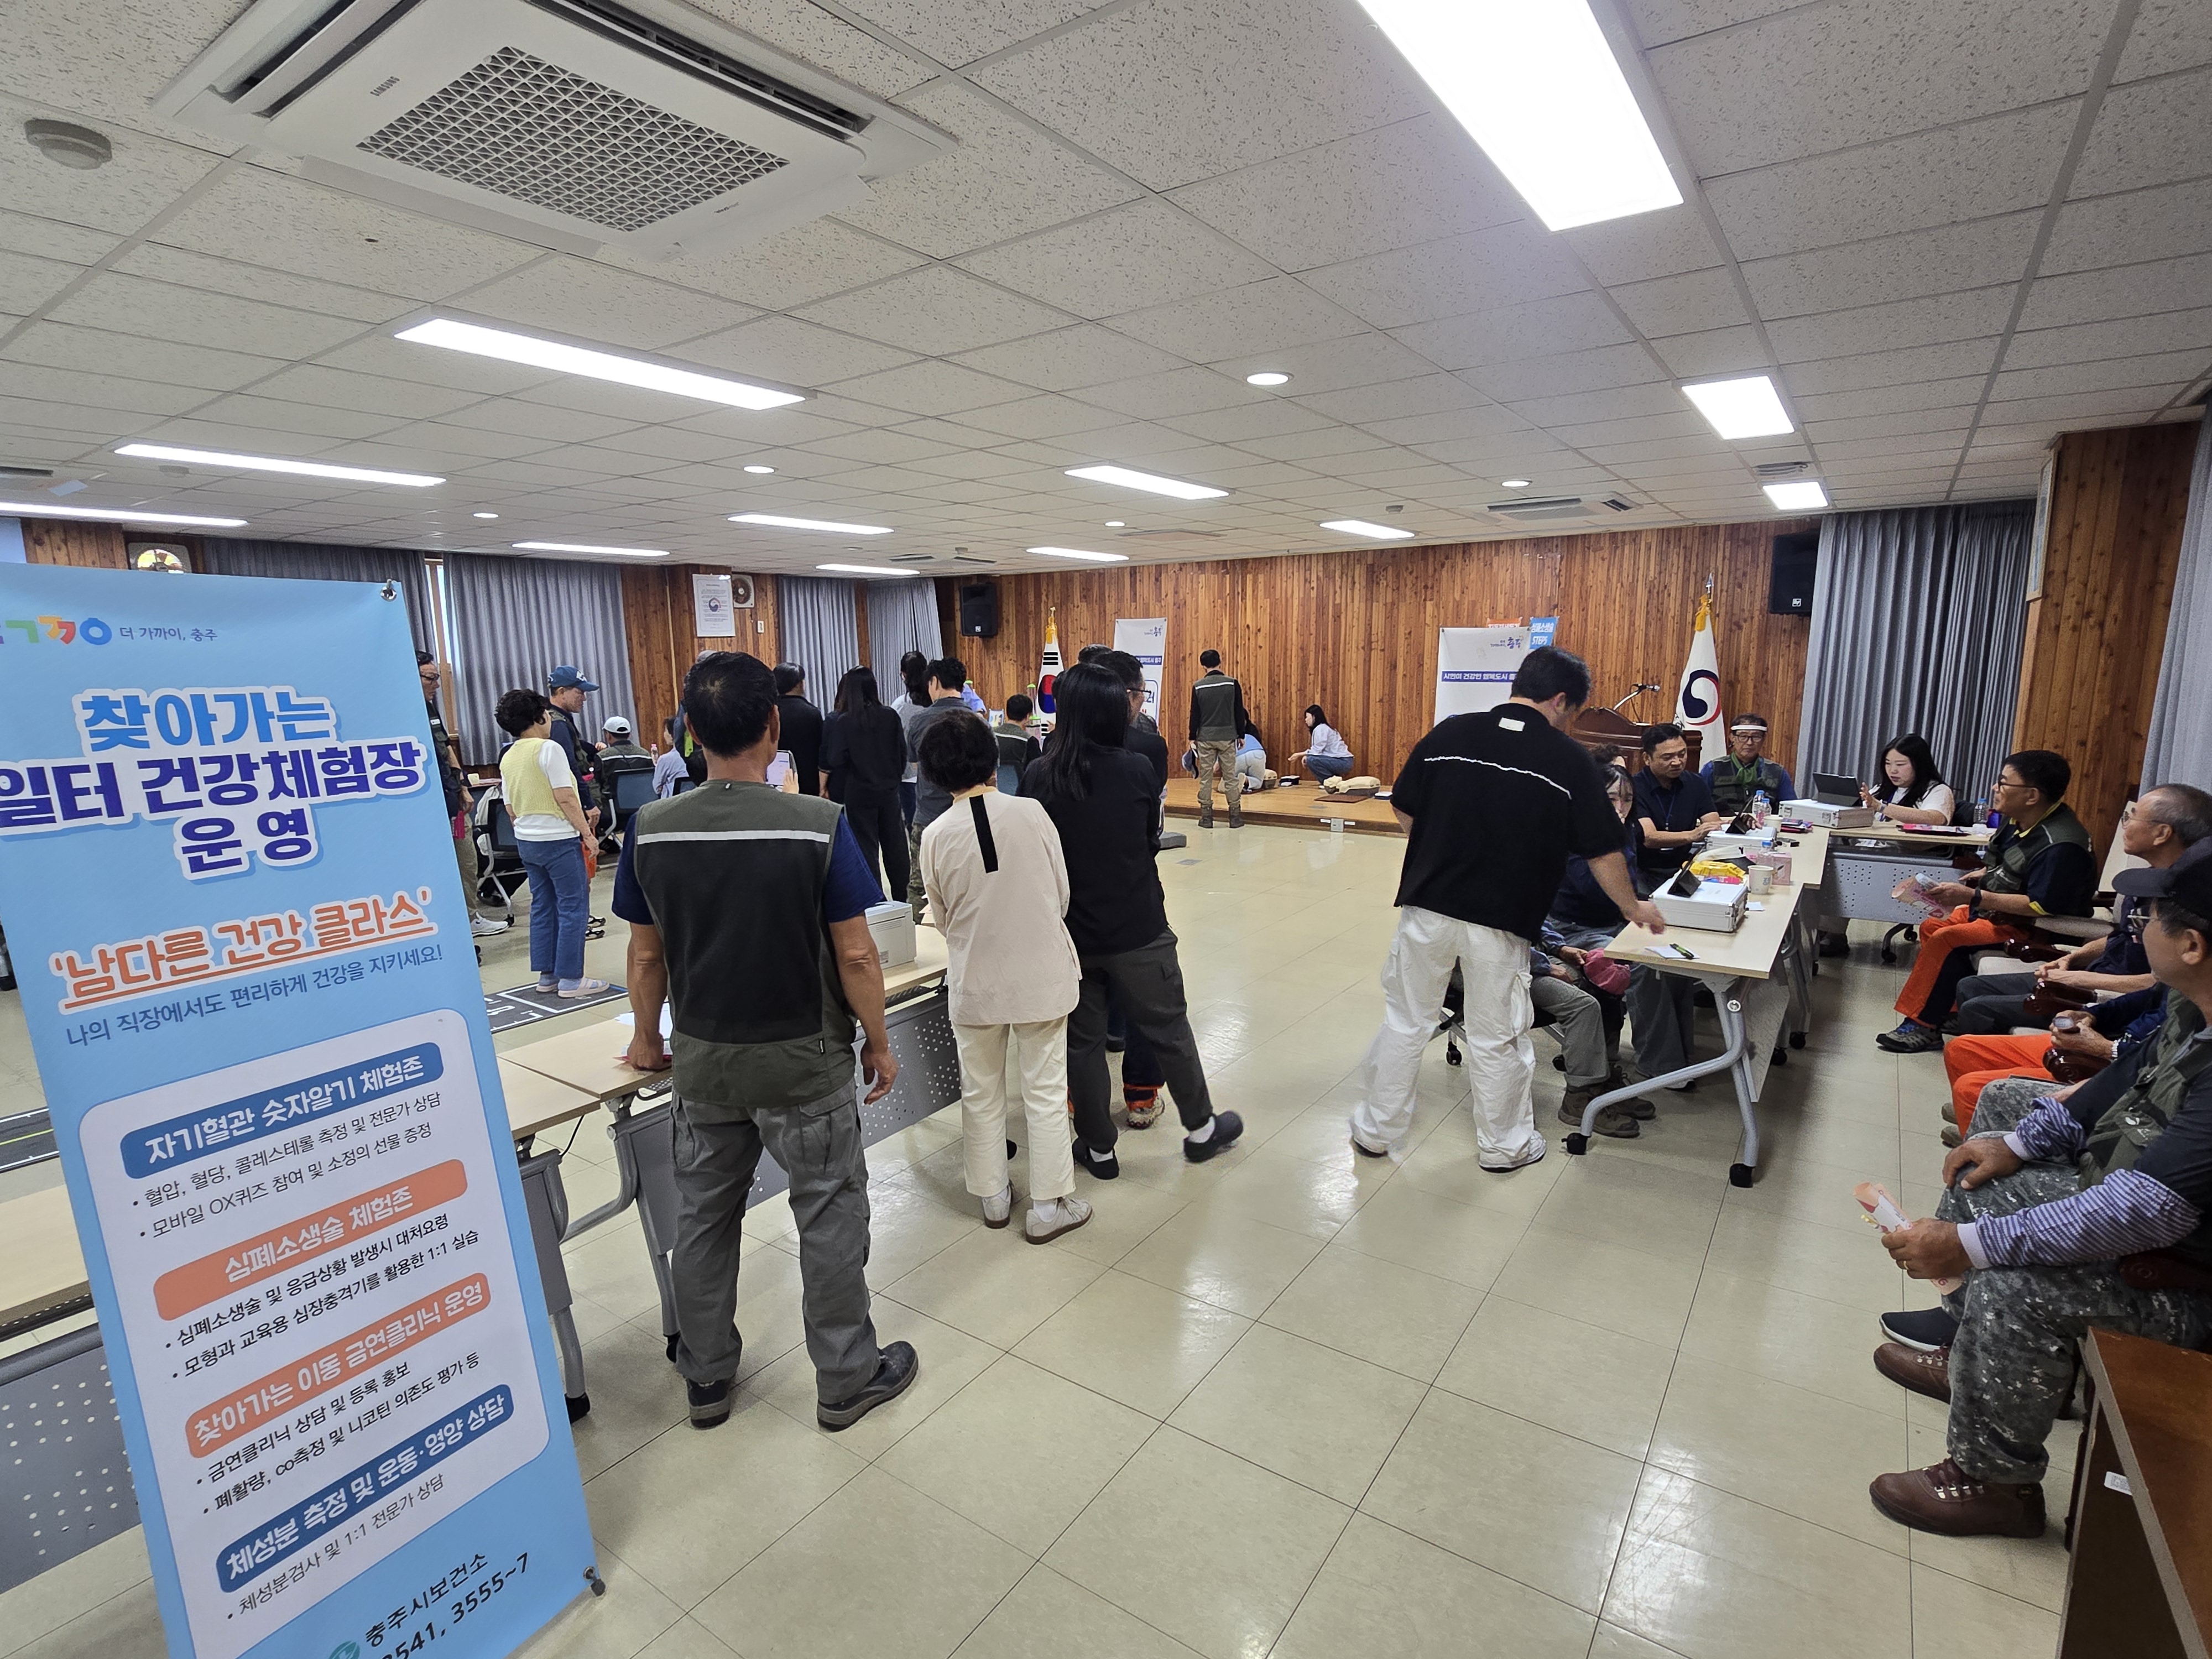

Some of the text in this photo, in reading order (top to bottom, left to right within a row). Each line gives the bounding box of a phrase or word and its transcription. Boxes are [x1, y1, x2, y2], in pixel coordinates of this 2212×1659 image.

[119, 627, 218, 642] 더 가까이, 충주
[81, 692, 330, 752] 찾아가는
[0, 742, 420, 828] 일터 건강체험장
[66, 944, 443, 1046] 나의 직장에서도 편리하게 건강을 지키세요!
[217, 914, 302, 964] 건강
[145, 1055, 424, 1164] 자기혈관 숫자알기 체험존
[145, 1092, 441, 1207] 혈압, 혈당, 콜레스테롤 측정 및 전문가 상담
[153, 1122, 432, 1238] 모바일 OX퀴즈 참여 및 소정의 선물 증정
[225, 1186, 413, 1282] 심폐소생술 체험존
[177, 1213, 448, 1347] 심폐소생술 및 응급상황 발생시 대처요령
[185, 1230, 479, 1377] 모형과 교육용 심장충격기를 활용한 1:1 실습
[195, 1281, 483, 1447] 찾아가는 이동 금연클리닉 운영
[208, 1361, 411, 1483] 금연클리닉 상담 및 등록 홍보
[215, 1471, 271, 1510] 폐활량,
[329, 1427, 345, 1447] 및
[348, 1401, 392, 1433] 니코틴
[395, 1376, 435, 1408] 의존도
[437, 1360, 463, 1385] 평가
[466, 1352, 479, 1369] 등
[226, 1517, 299, 1580] 체성분
[304, 1488, 348, 1530] 측정
[351, 1472, 375, 1503] 및
[467, 1394, 505, 1431] 상담
[239, 1473, 444, 1615] 체성분검사 및 1:1 전문가 상담
[365, 1553, 488, 1647] 충주시보건소
[451, 1552, 528, 1624] 3555~7
